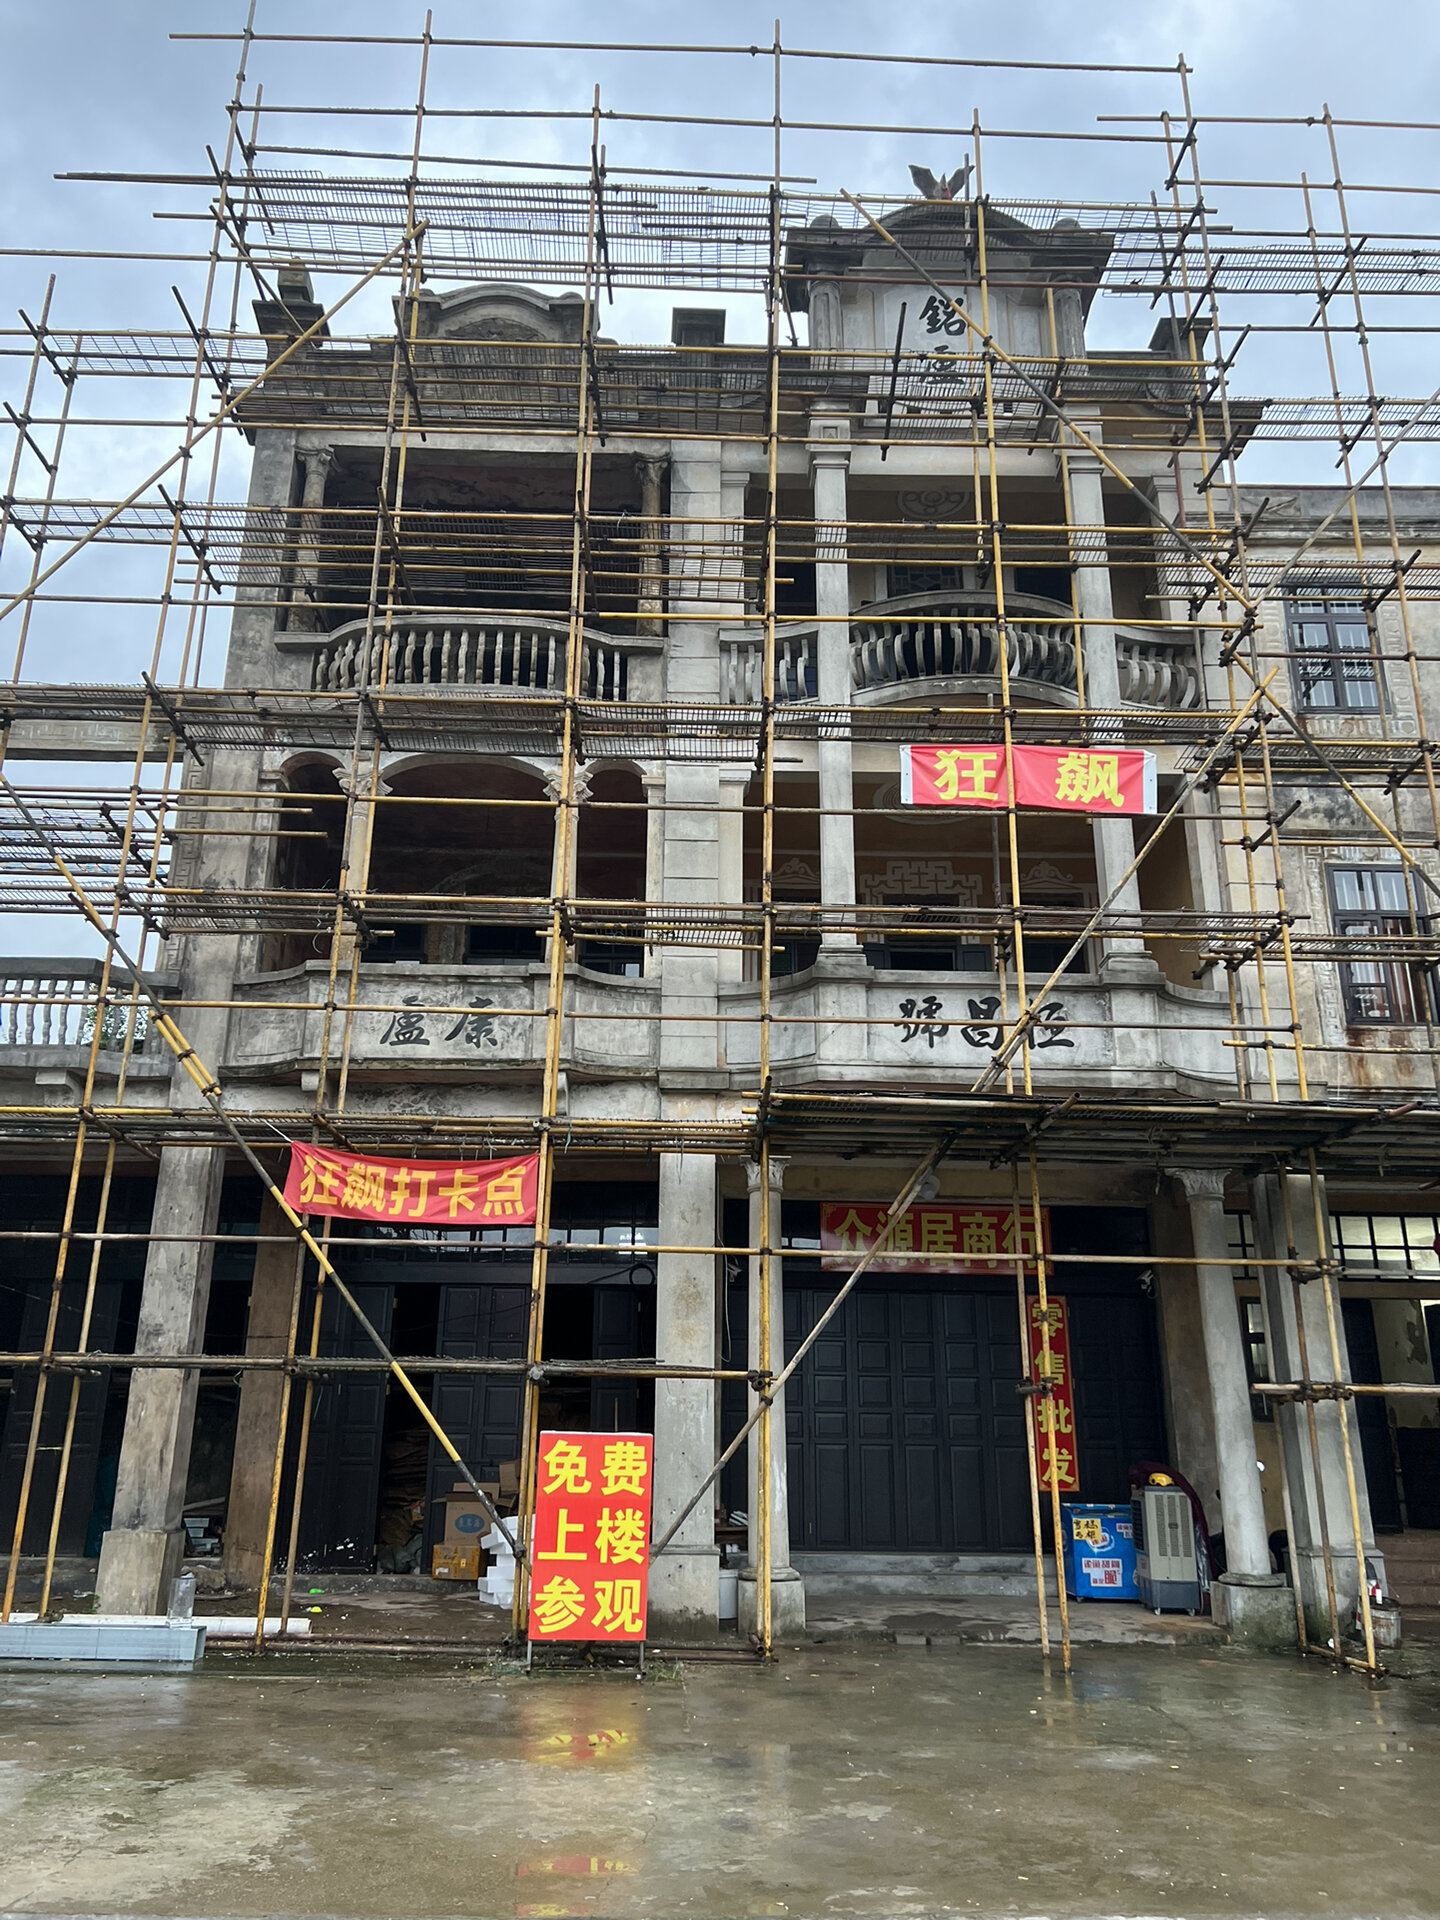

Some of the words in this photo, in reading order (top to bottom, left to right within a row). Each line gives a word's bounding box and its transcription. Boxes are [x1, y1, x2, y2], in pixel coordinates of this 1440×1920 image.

[300, 1154, 527, 1218] 狂飙打卡点
[1032, 1302, 1075, 1485] 零售批发
[543, 1440, 648, 1496] 免费
[537, 1507, 647, 1565] 上楼
[534, 1575, 644, 1634] 参观
